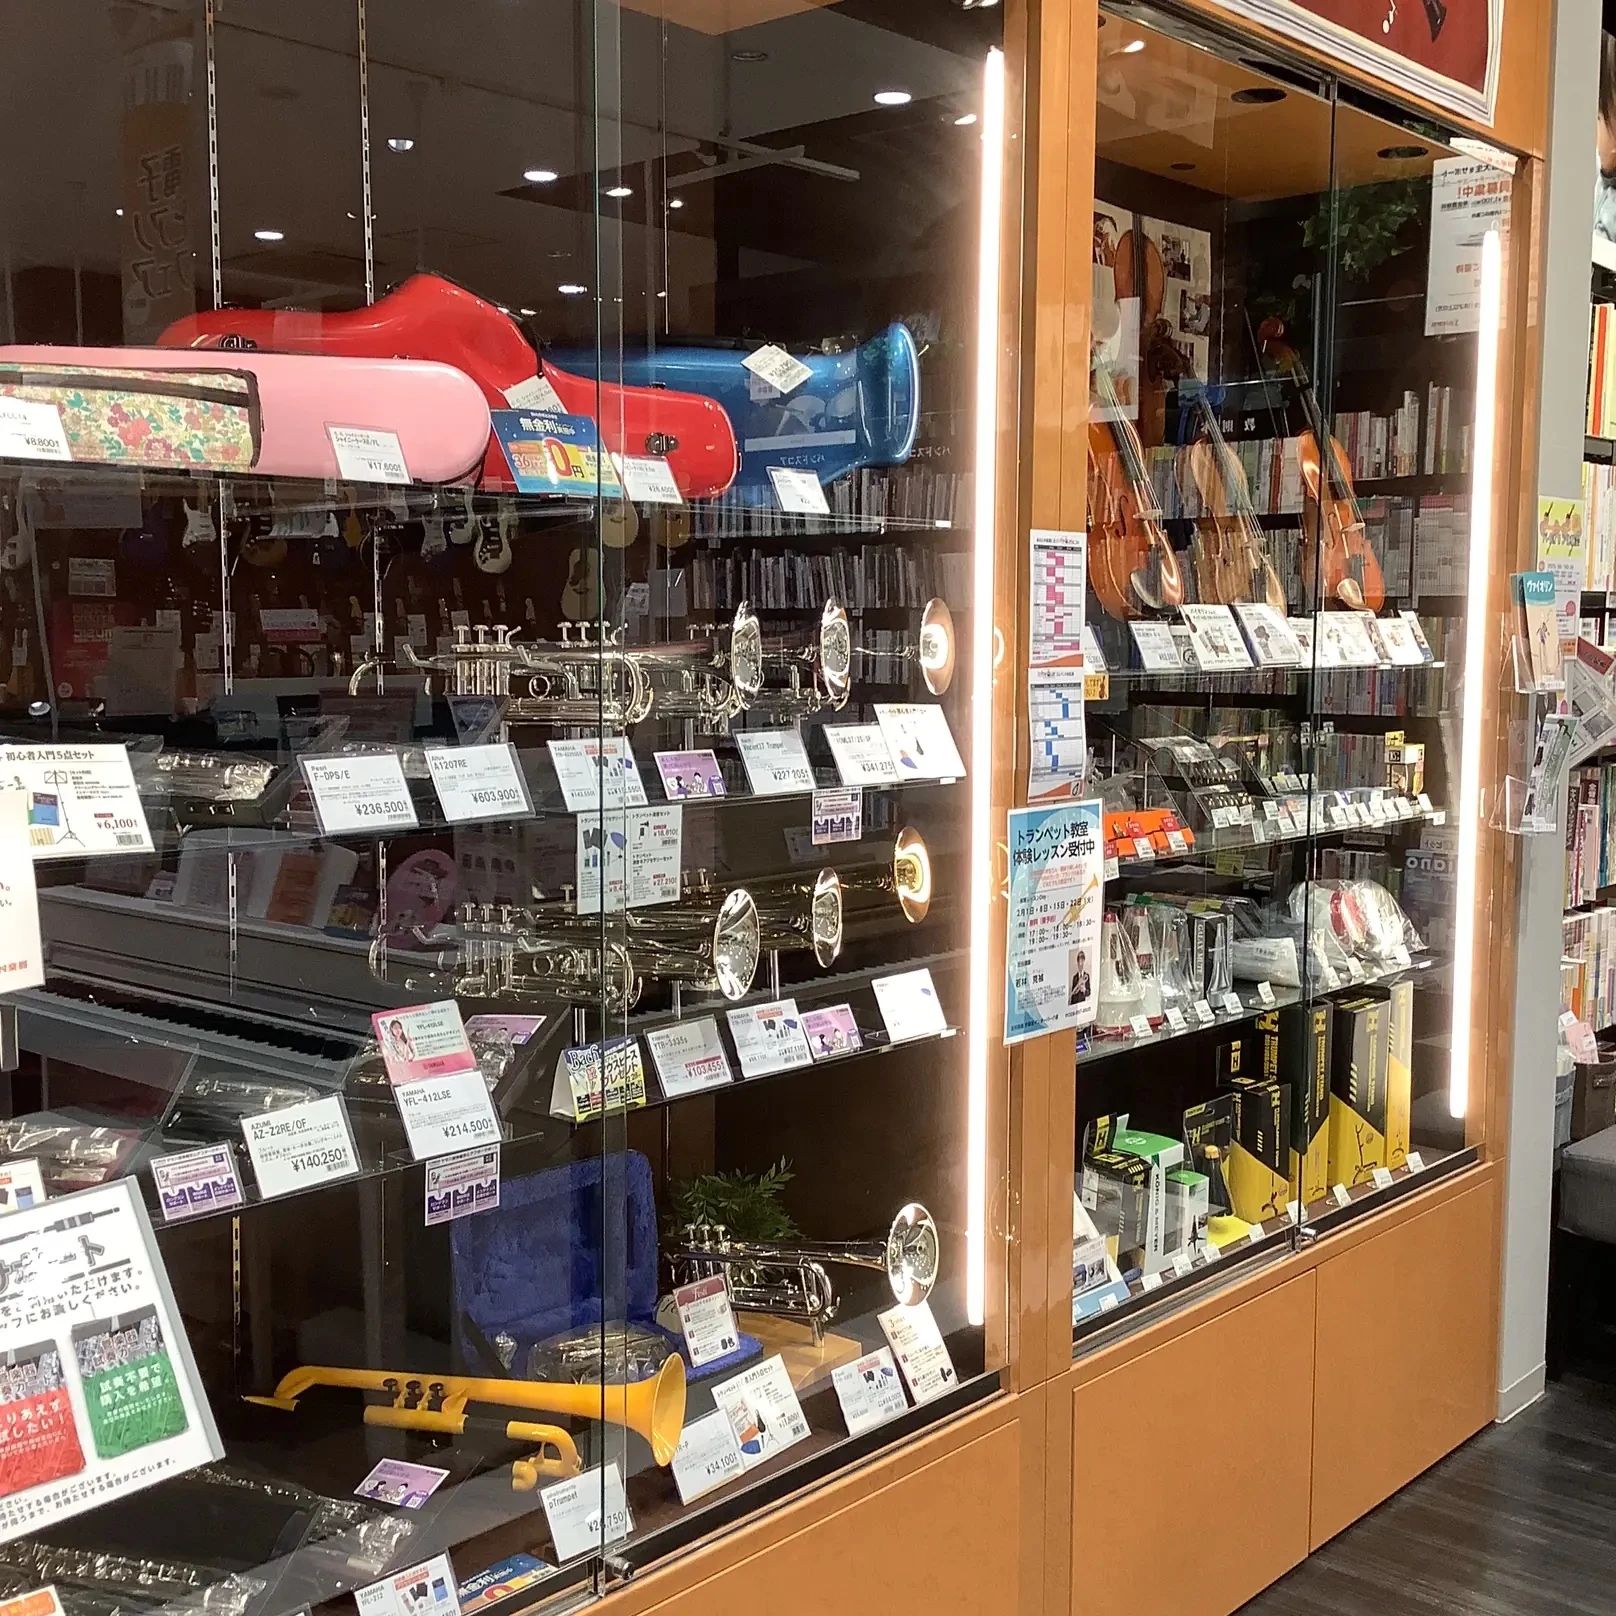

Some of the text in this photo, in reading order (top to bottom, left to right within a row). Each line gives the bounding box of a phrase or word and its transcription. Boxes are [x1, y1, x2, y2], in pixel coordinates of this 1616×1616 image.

[6, 750, 94, 761] 初心者入門5点セット
[434, 760, 468, 771] A1207RE
[314, 771, 351, 782] F-DPS/E
[472, 789, 515, 804] ¥603,900
[354, 801, 403, 816] ¥236,500
[1018, 821, 1089, 846] トランペット教室
[1013, 839, 1095, 867] 体験レッスン受付中
[402, 1088, 425, 1097] YAMAHA
[404, 1090, 452, 1105] YFL-412LSE
[442, 1118, 490, 1138] ¥214,500
[291, 1148, 342, 1172] ¥140,250
[100, 1375, 163, 1407] 購入を希望
[548, 1492, 578, 1510] pTrumpet
